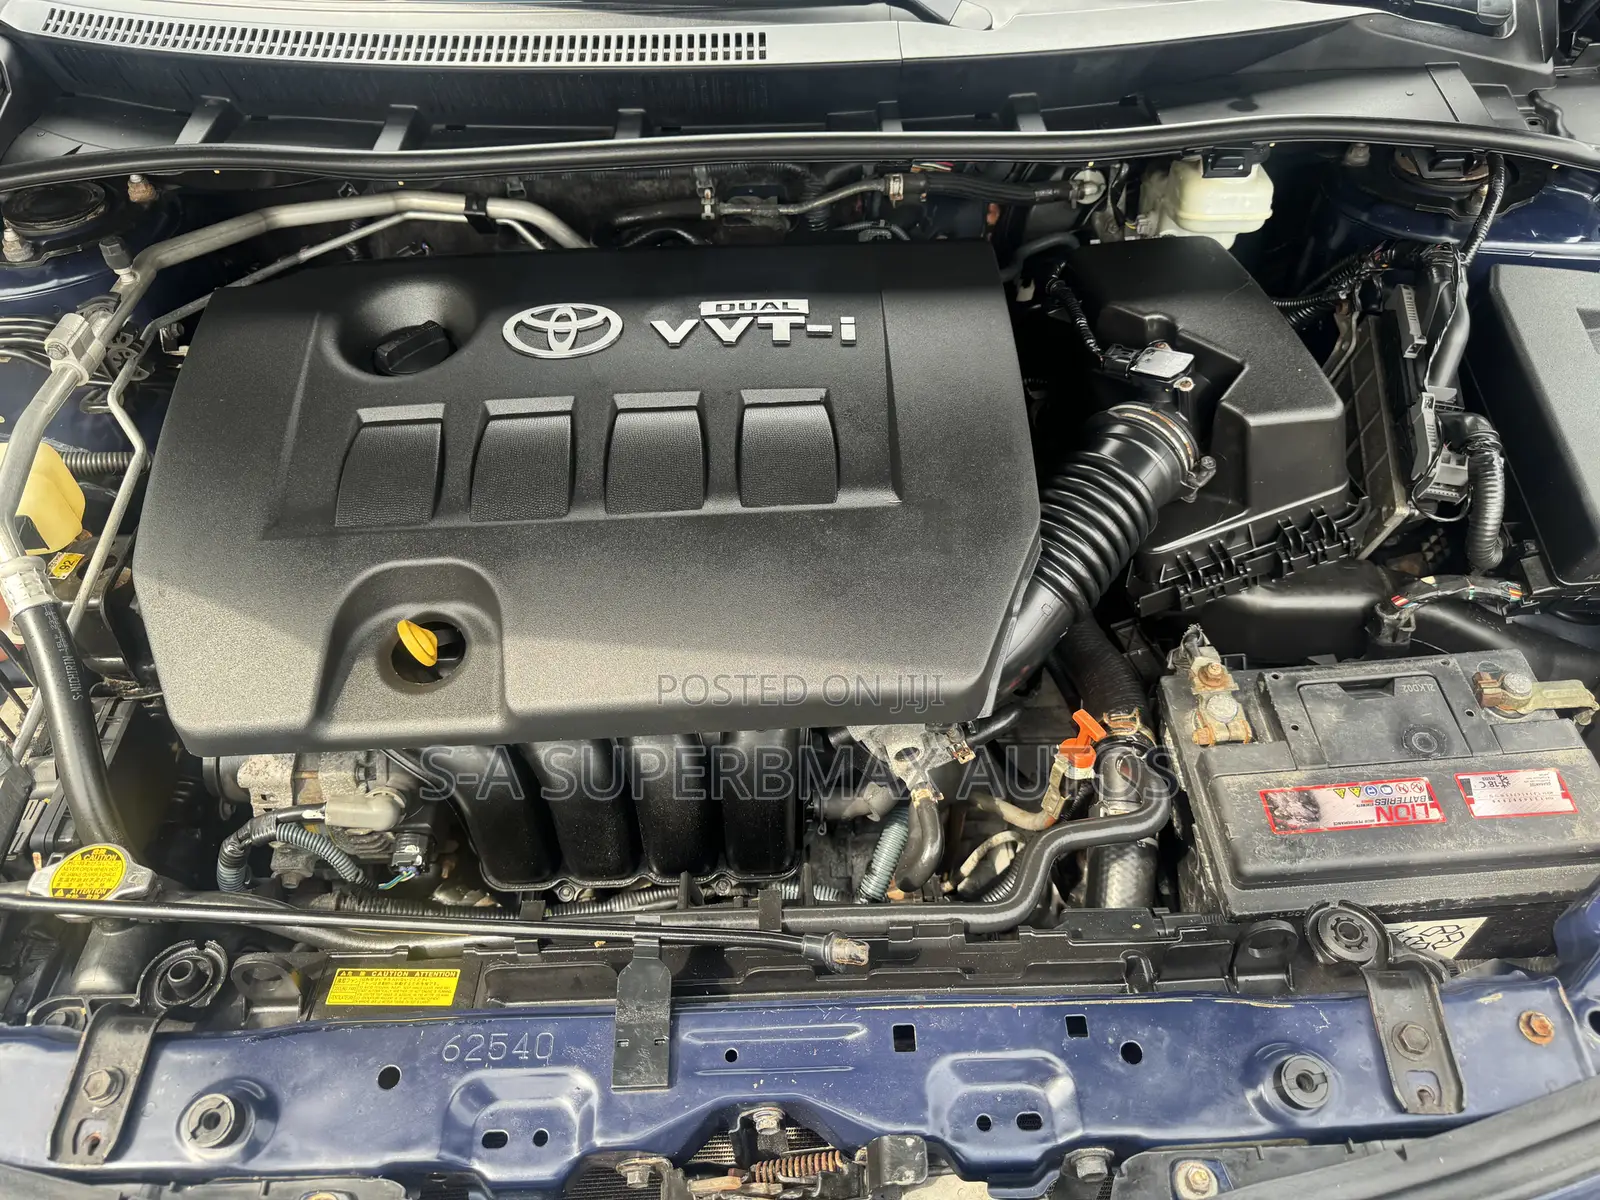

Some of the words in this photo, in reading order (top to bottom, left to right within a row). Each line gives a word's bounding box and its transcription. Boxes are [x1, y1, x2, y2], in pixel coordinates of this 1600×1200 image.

[715, 301, 800, 312] DUAL
[650, 316, 857, 347] VVT-i
[1374, 795, 1427, 806] BATTERIES
[1375, 804, 1430, 822] LION
[442, 1032, 555, 1062] 62540
